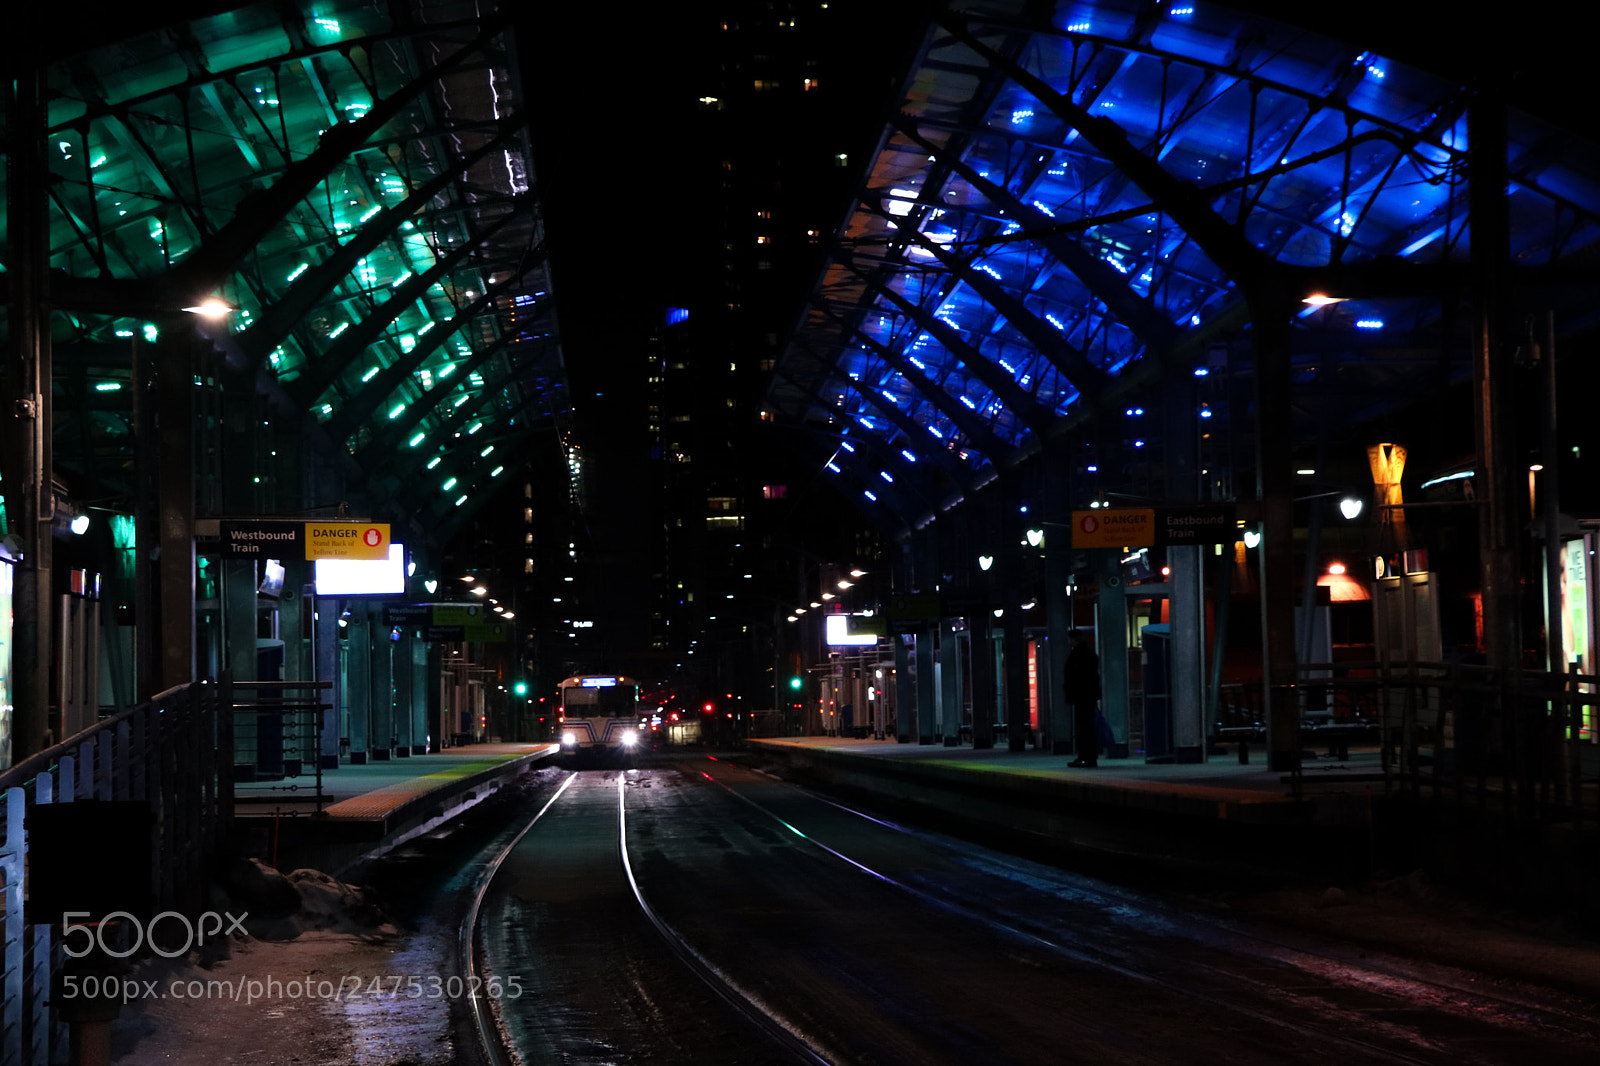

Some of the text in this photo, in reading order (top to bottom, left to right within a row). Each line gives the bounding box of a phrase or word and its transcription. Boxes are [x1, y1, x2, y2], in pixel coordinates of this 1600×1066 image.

[1103, 515, 1147, 524] DANGER
[1166, 514, 1225, 525] Eastbound
[230, 530, 296, 541] Westbound
[313, 529, 358, 538] DANGER
[1167, 529, 1195, 538] Train
[230, 543, 260, 553] Train
